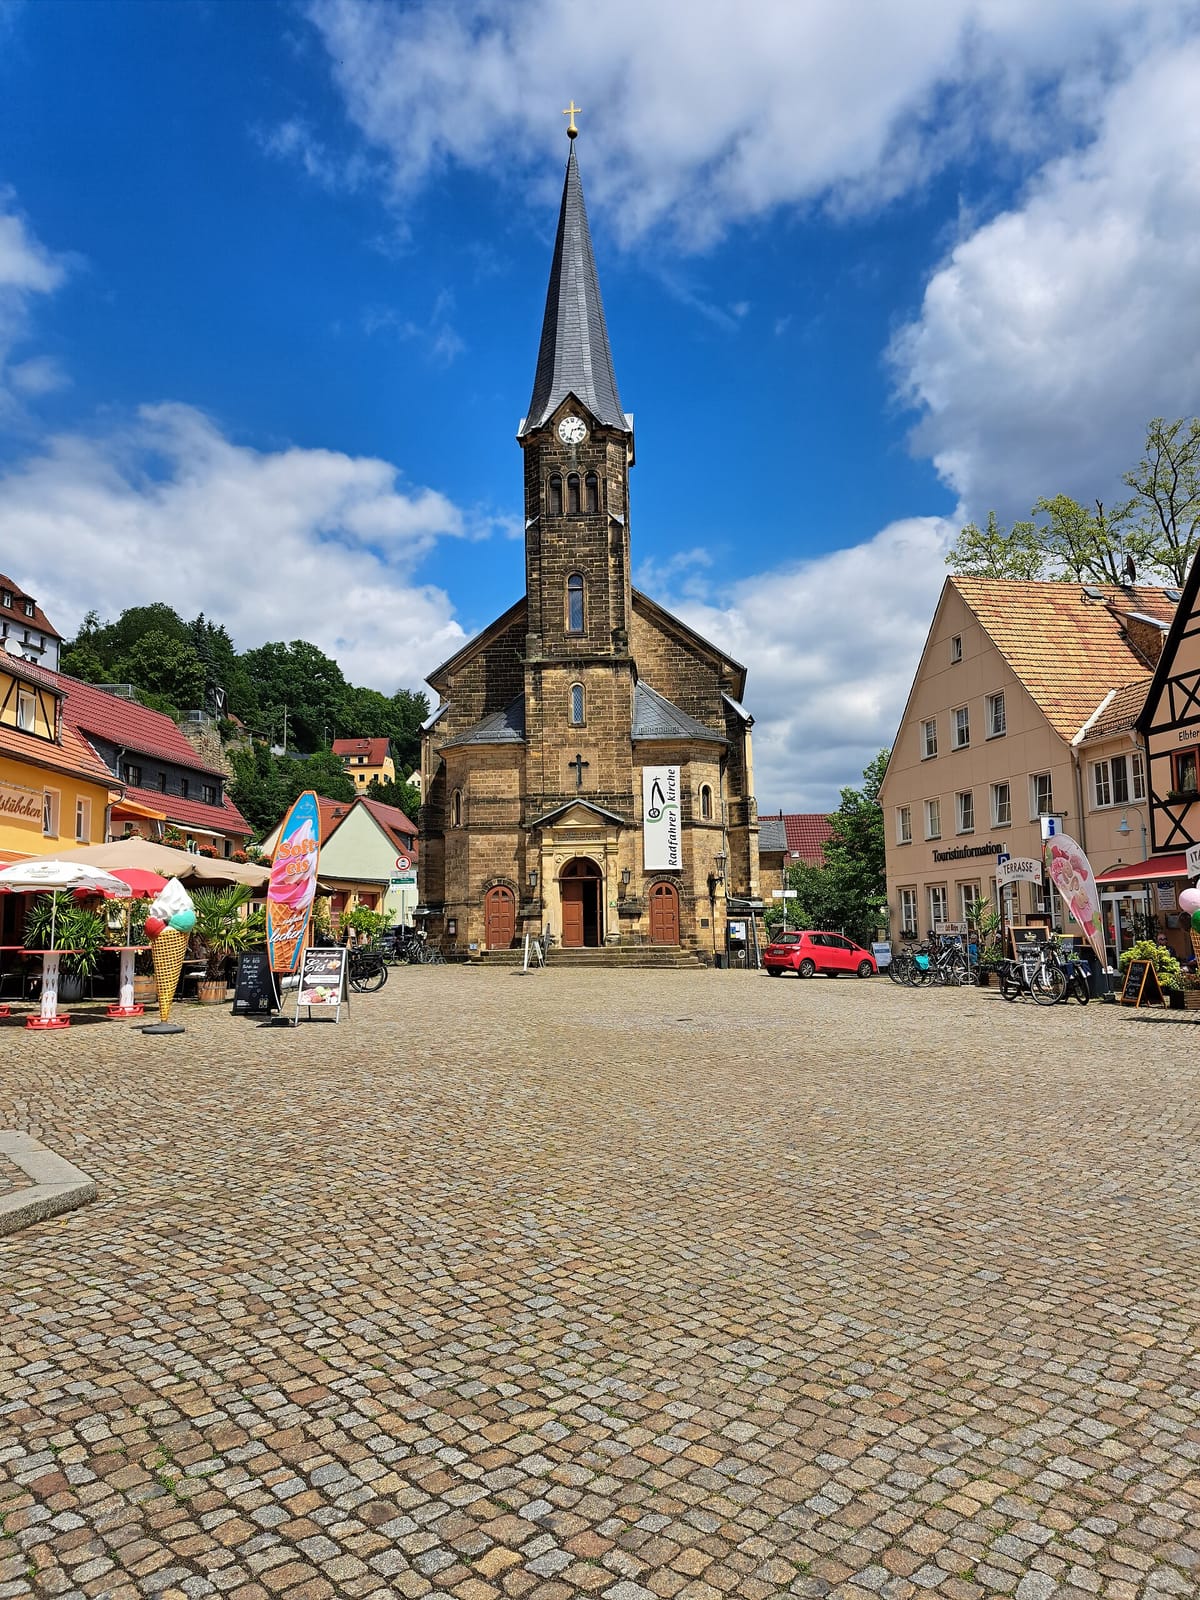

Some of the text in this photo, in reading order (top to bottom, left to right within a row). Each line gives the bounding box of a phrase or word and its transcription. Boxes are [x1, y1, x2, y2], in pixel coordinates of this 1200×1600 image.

[666, 768, 678, 866] Radfahrer kirche
[931, 841, 1003, 863] Touristinformation
[286, 857, 309, 876] eis
[1003, 861, 1033, 875] TERRASSE
[304, 958, 328, 972] Eis
